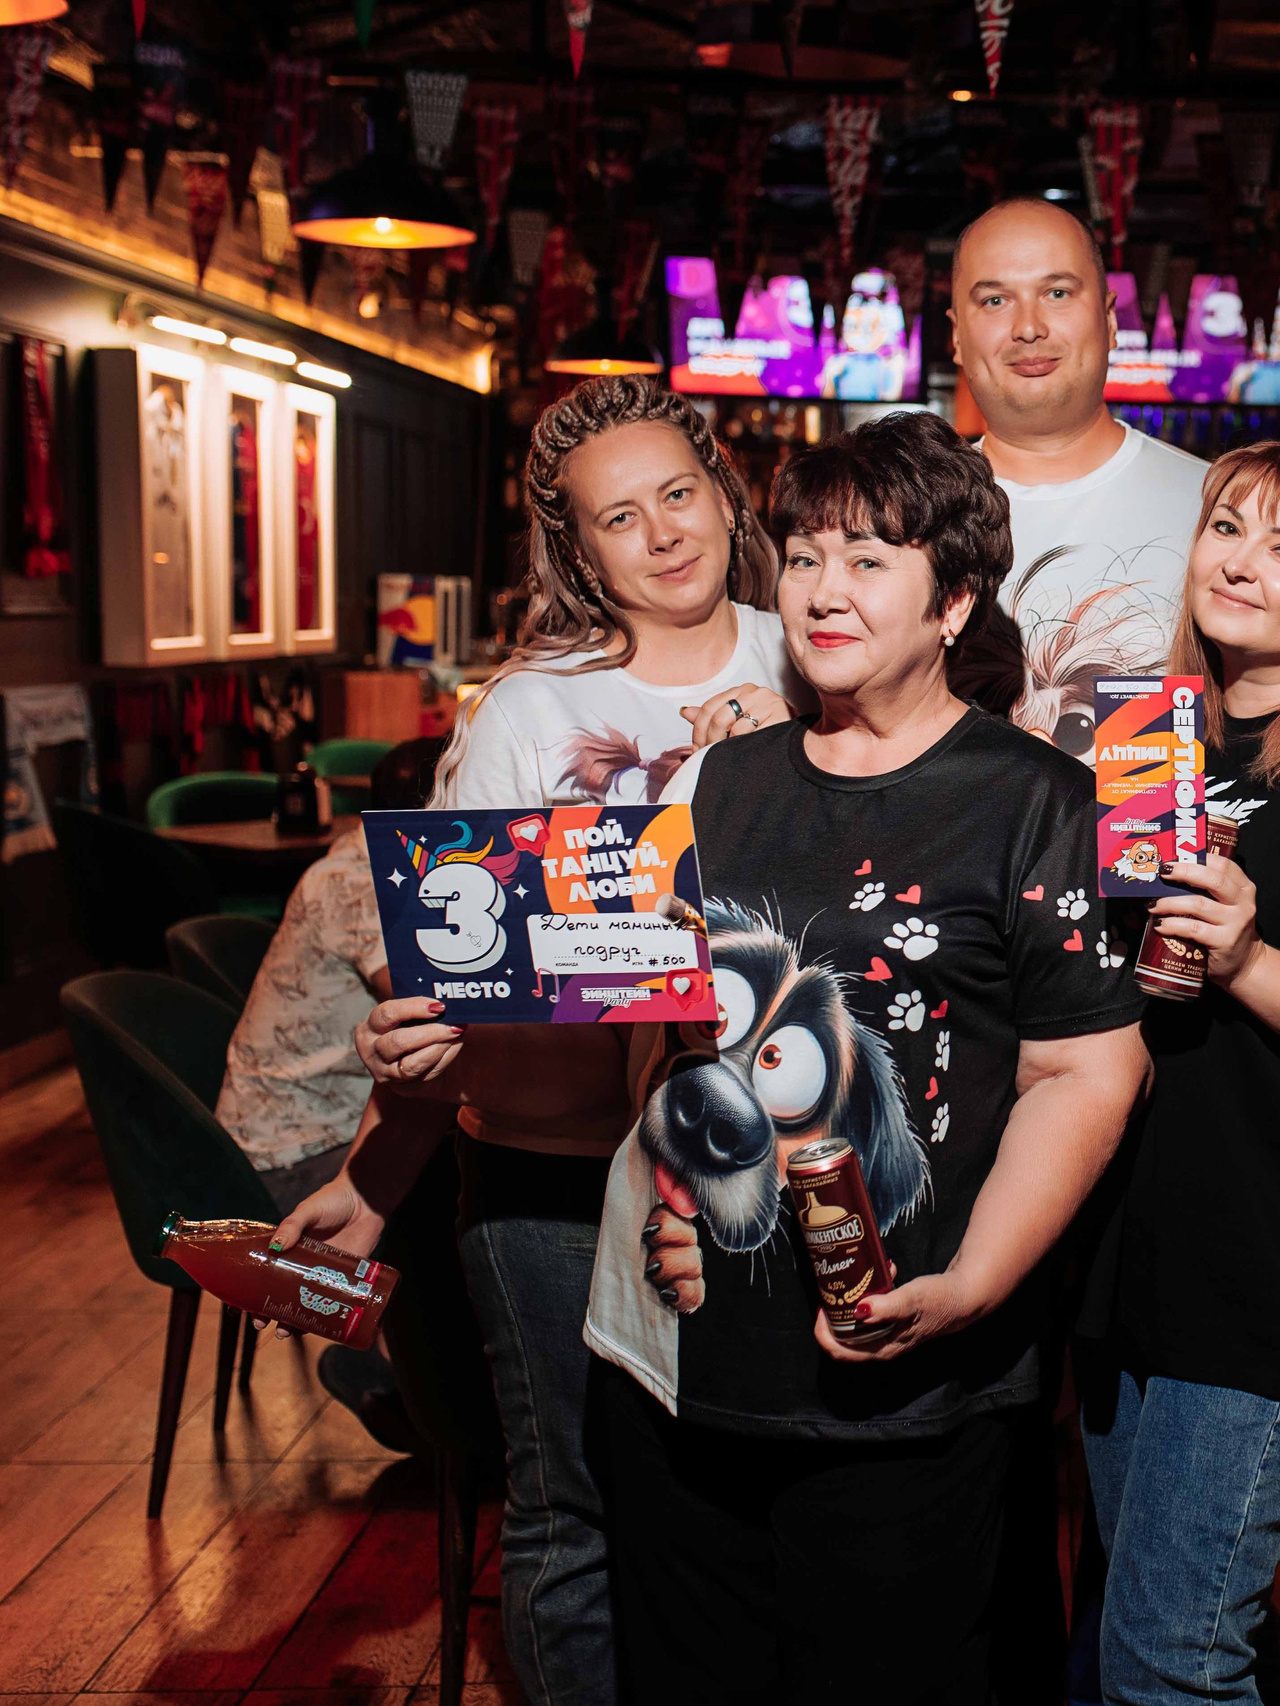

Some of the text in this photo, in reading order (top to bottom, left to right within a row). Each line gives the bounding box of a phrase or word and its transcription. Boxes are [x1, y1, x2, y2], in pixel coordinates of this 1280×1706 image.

[1202, 292, 1243, 337] 3
[1099, 744, 1168, 761] ПИЦЦУ
[1172, 686, 1198, 863] СЕРТИФИКА
[563, 819, 632, 850] ПОЙ,
[541, 841, 668, 879] ТАНЦУЙ,
[569, 873, 656, 903] ЛЮБИ
[416, 862, 507, 974] 3
[540, 912, 686, 932] Дети маминых
[574, 945, 641, 962] подруг
[433, 981, 511, 999] МЕСТО
[603, 997, 632, 1008] Party
[814, 1257, 855, 1277] Pilsner
